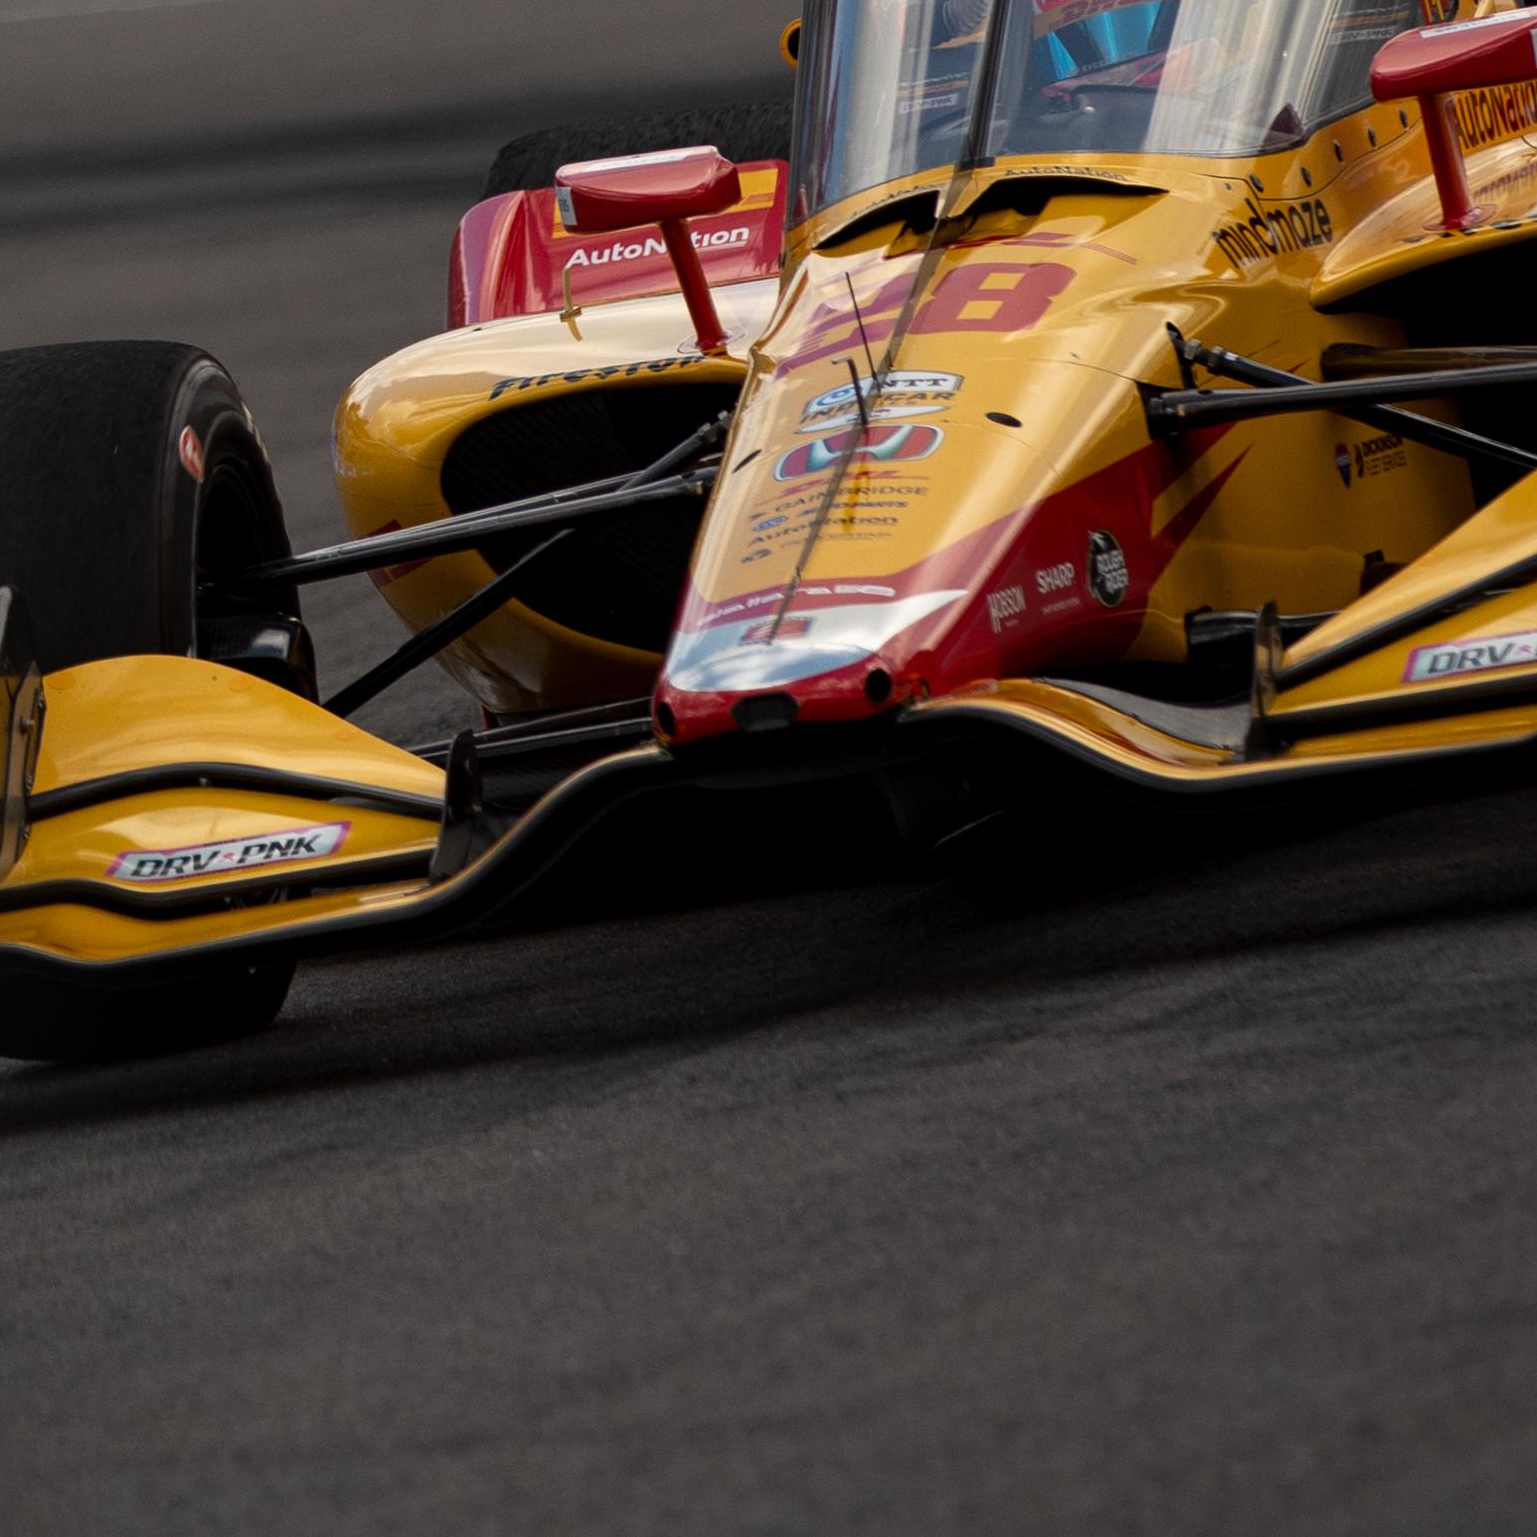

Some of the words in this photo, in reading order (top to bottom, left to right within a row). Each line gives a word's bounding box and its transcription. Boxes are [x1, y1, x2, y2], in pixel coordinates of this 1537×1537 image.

[563, 227, 750, 270] AutoNtion
[1212, 197, 1333, 270] mindmaze
[1035, 560, 1075, 595] SHARP
[1427, 642, 1517, 675] DRV
[129, 850, 221, 877] DRV
[236, 834, 323, 864] PNK
